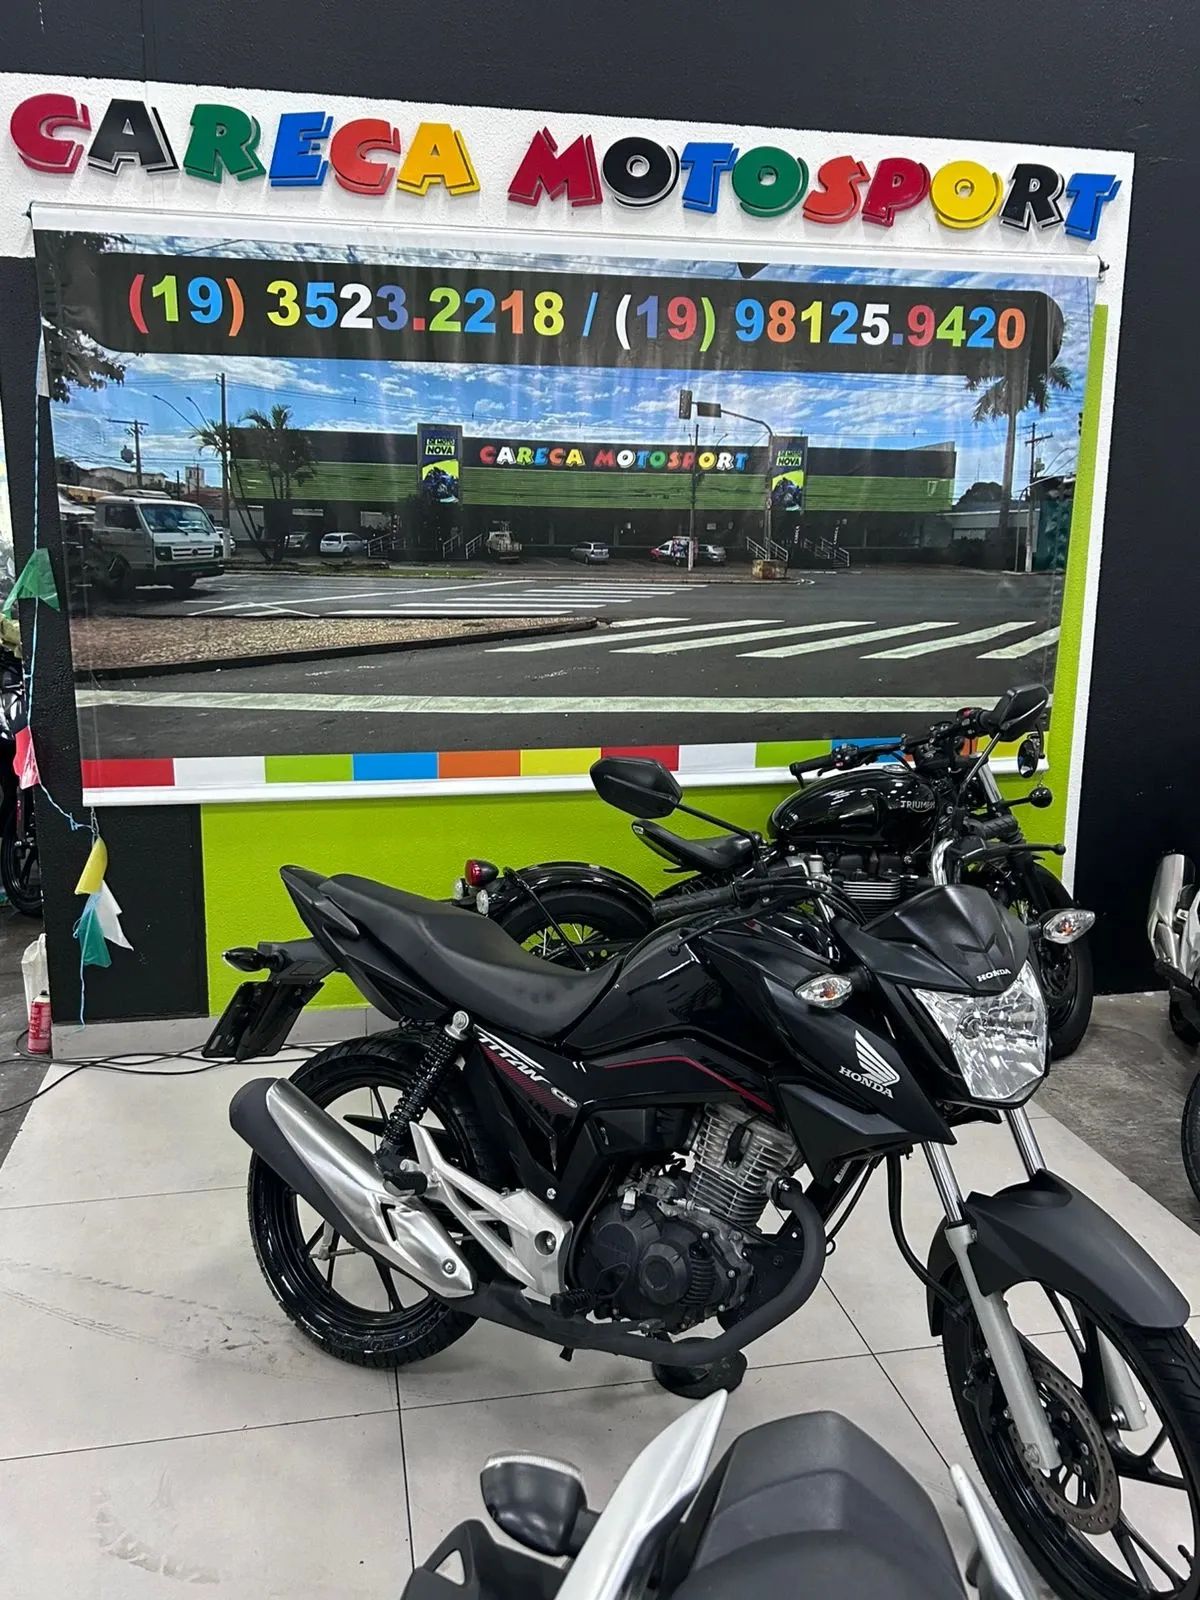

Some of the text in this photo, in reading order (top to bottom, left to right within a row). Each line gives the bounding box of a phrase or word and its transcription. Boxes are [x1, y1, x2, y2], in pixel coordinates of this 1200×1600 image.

[10, 93, 1122, 240] CARECA MOTOSPORT
[129, 273, 1026, 352] (19) 3523.2218 / (19) 98125.9420
[426, 445, 455, 455] NOVA
[479, 445, 749, 472] CARECA MOTOSPORT
[777, 456, 801, 466] NOVA
[976, 968, 1012, 982] HONDA
[838, 1065, 895, 1099] HONDA
